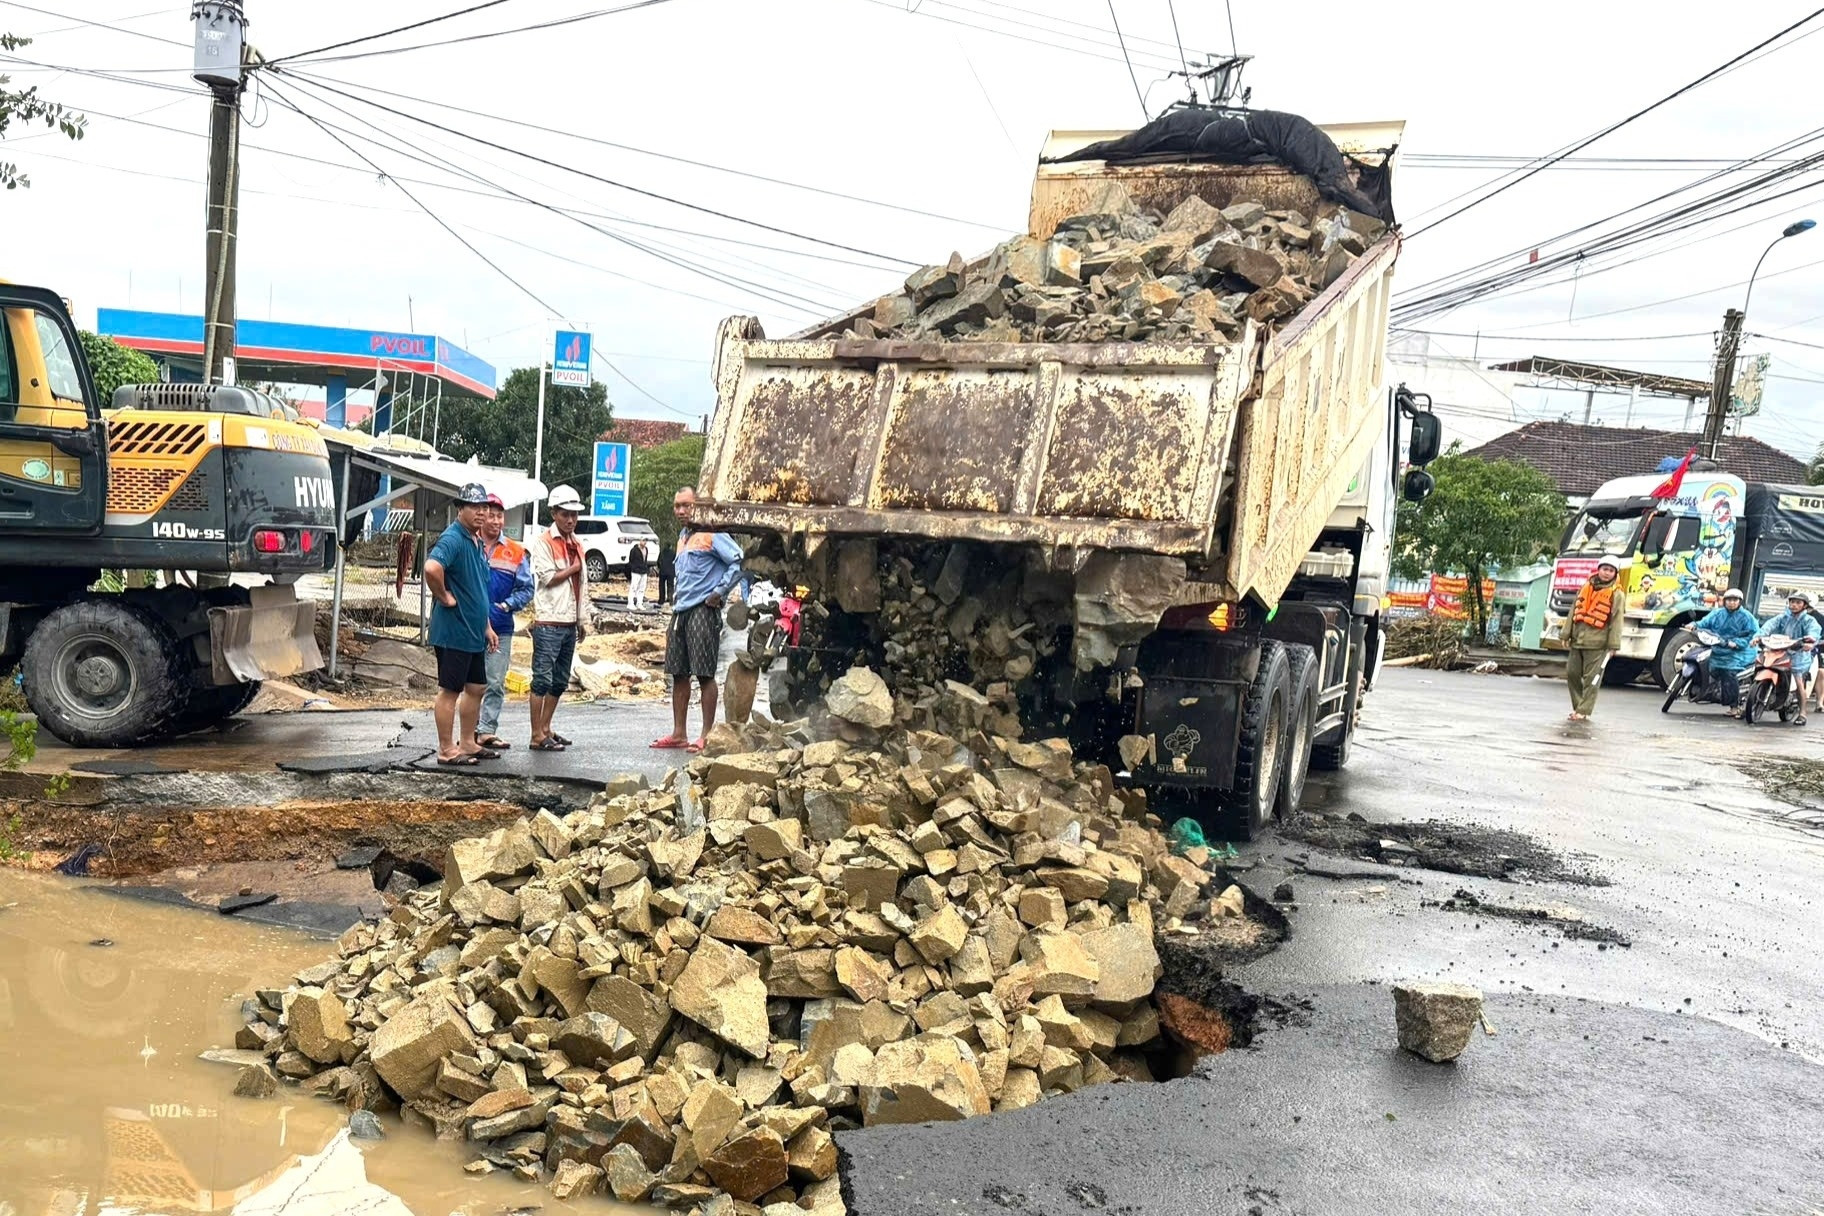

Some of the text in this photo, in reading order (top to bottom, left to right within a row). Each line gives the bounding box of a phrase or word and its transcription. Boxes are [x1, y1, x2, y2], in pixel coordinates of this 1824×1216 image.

[371, 335, 429, 356] PVOIL
[556, 371, 584, 382] PVOIL
[598, 481, 620, 489] PVOIL
